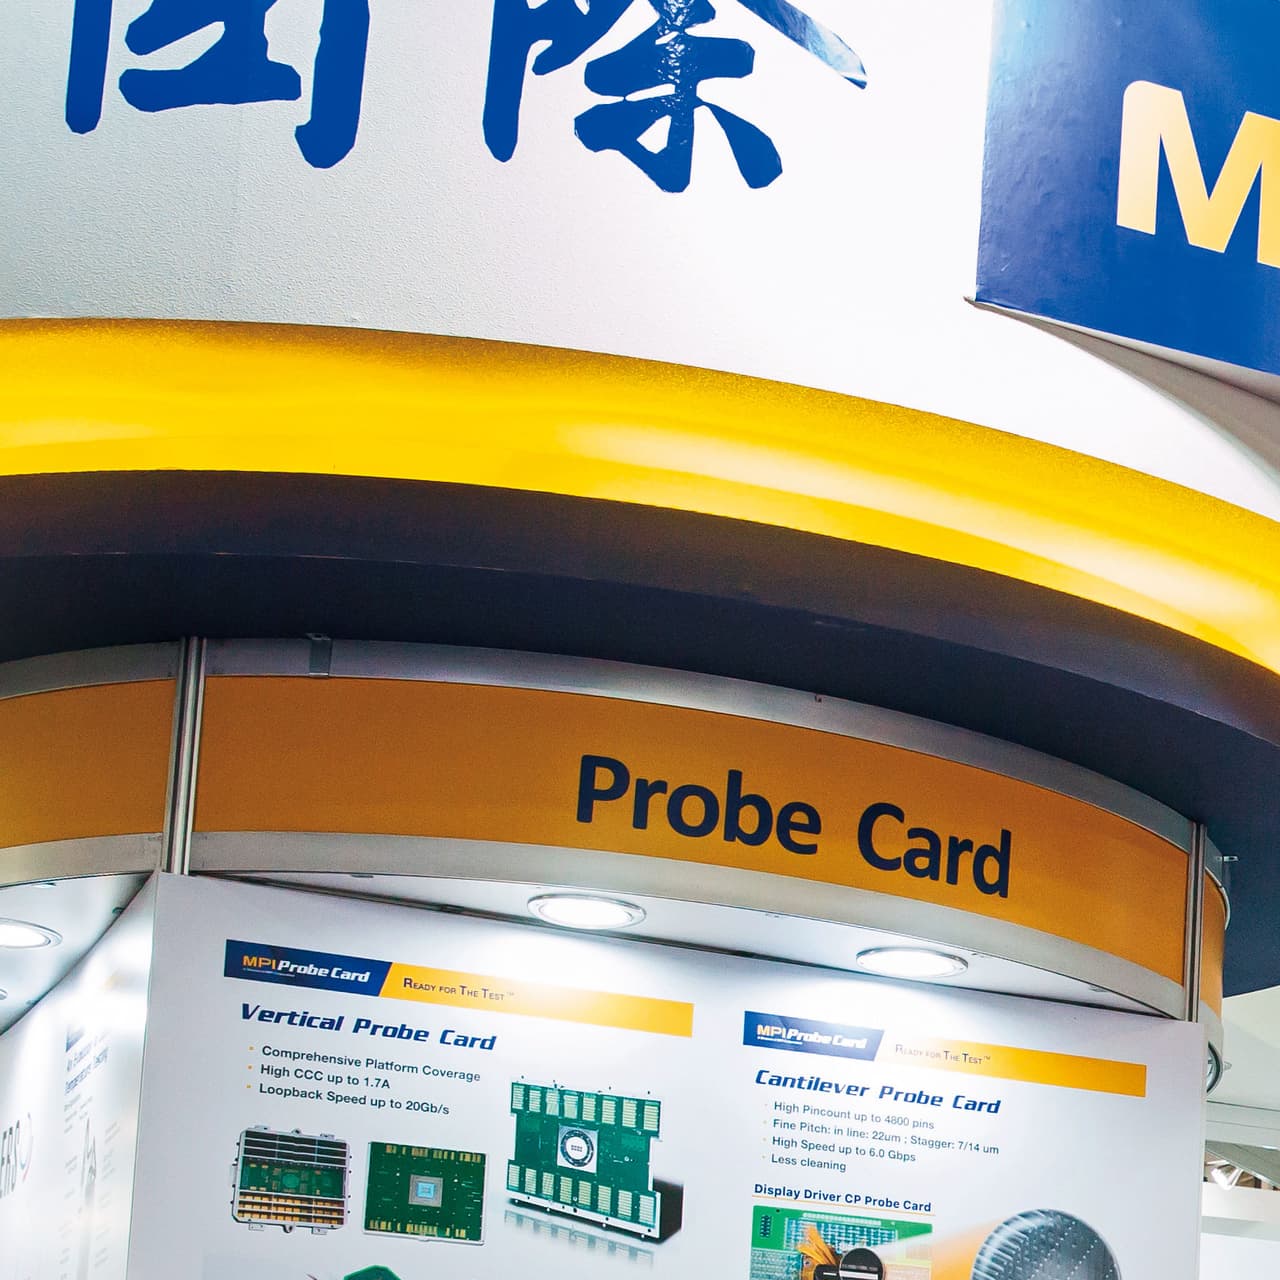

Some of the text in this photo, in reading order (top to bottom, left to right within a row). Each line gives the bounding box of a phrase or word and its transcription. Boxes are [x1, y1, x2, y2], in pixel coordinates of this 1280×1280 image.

[576, 753, 1012, 899] Probe Card
[242, 955, 276, 970] MPI
[331, 967, 370, 983] Card
[403, 977, 436, 993] READY
[241, 1003, 498, 1051] Vertical Probe Card
[260, 1064, 391, 1090] High CCC up to 1.7A
[262, 1045, 481, 1083] Comprehensive Platform Coverage
[259, 1083, 450, 1115] Loopback Speed up to 20Gb/s
[755, 1069, 1001, 1114] Cantilever Probe Card
[774, 1101, 799, 1114] High
[803, 1105, 851, 1120] Pincount
[854, 1112, 867, 1122] up
[871, 1113, 882, 1123] to
[912, 1118, 934, 1130] pins
[772, 1136, 916, 1163] High Speed up to 6.0 Gbps
[773, 1119, 796, 1131] Fine
[834, 1125, 844, 1136] in
[958, 1140, 980, 1152] 7/14
[983, 1145, 999, 1155] um
[771, 1153, 846, 1173] Less cleaning
[754, 1183, 932, 1212] Display Driver CP Probe Card
